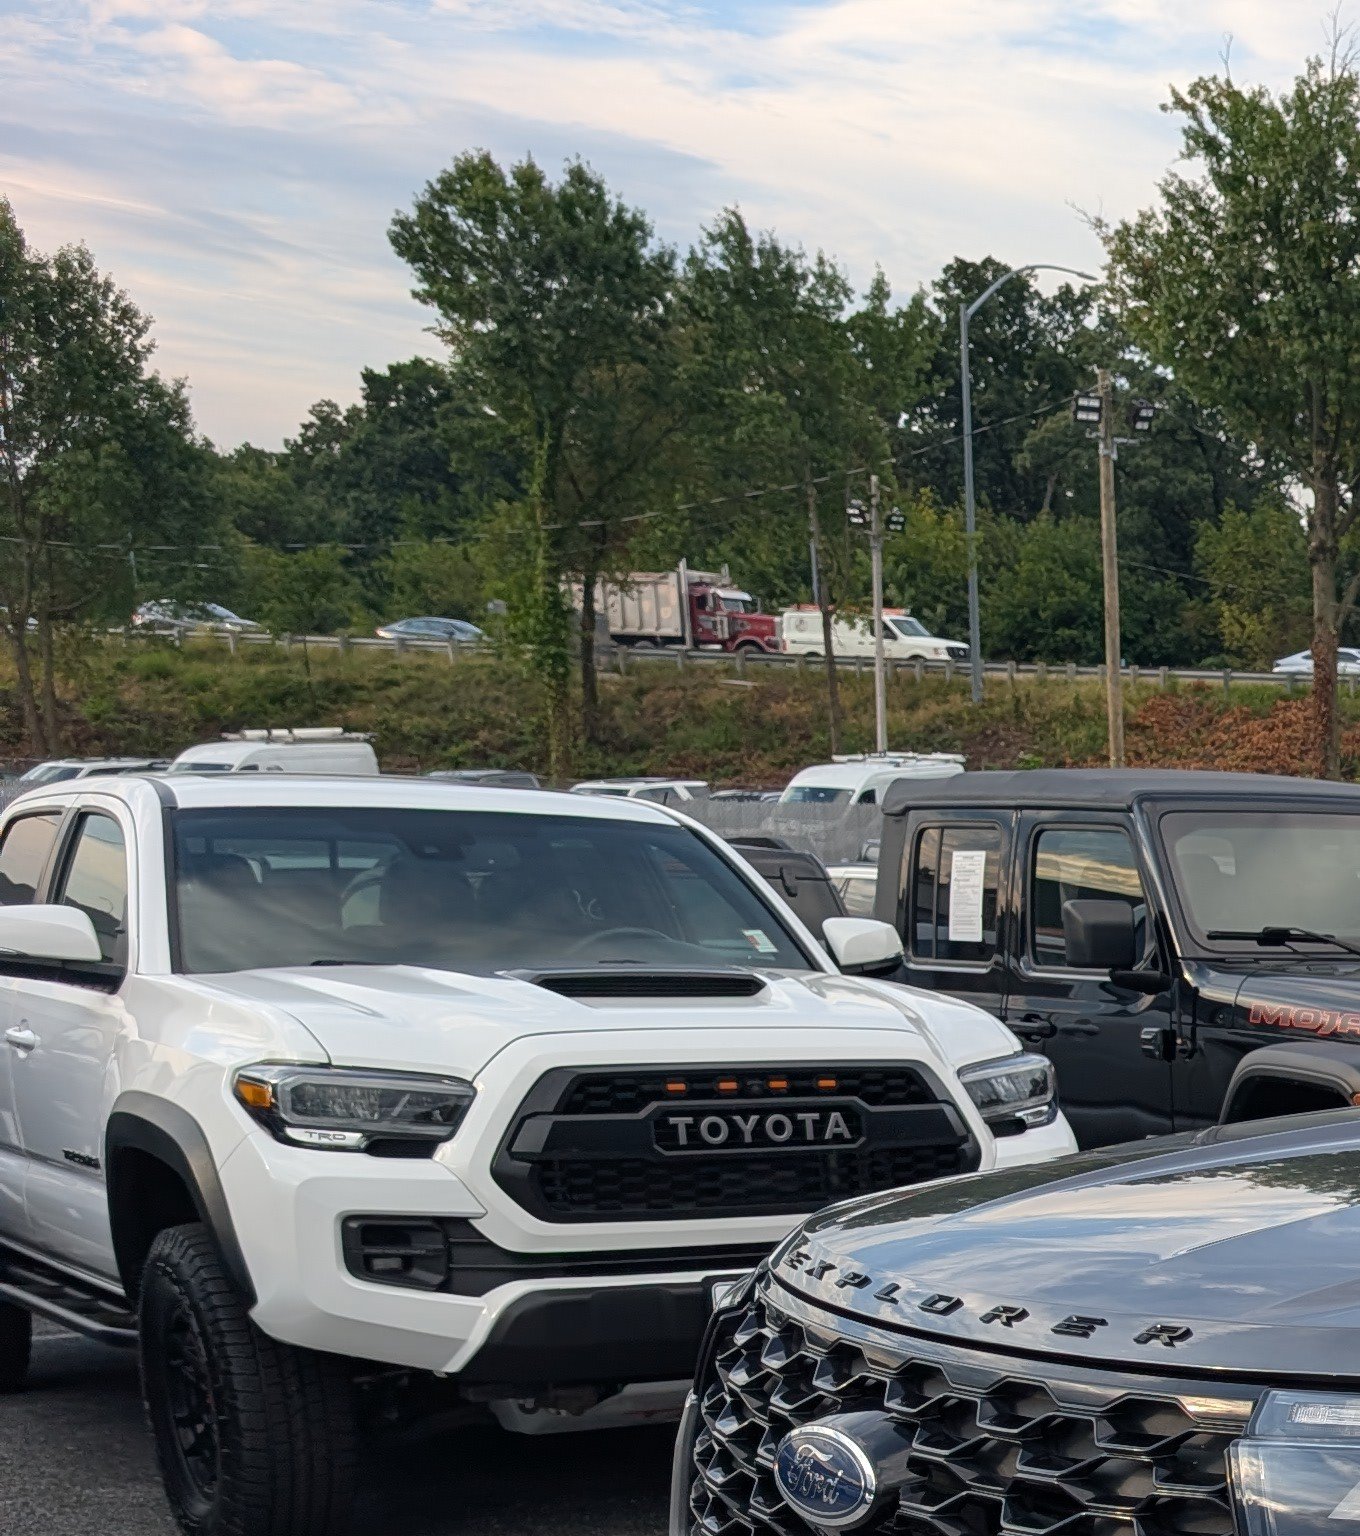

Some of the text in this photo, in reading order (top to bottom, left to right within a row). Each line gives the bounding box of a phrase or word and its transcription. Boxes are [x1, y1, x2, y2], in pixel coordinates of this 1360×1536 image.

[304, 1130, 347, 1142] TRD
[667, 1111, 853, 1147] TOYOTA
[782, 1249, 1195, 1349] EXPLORER
